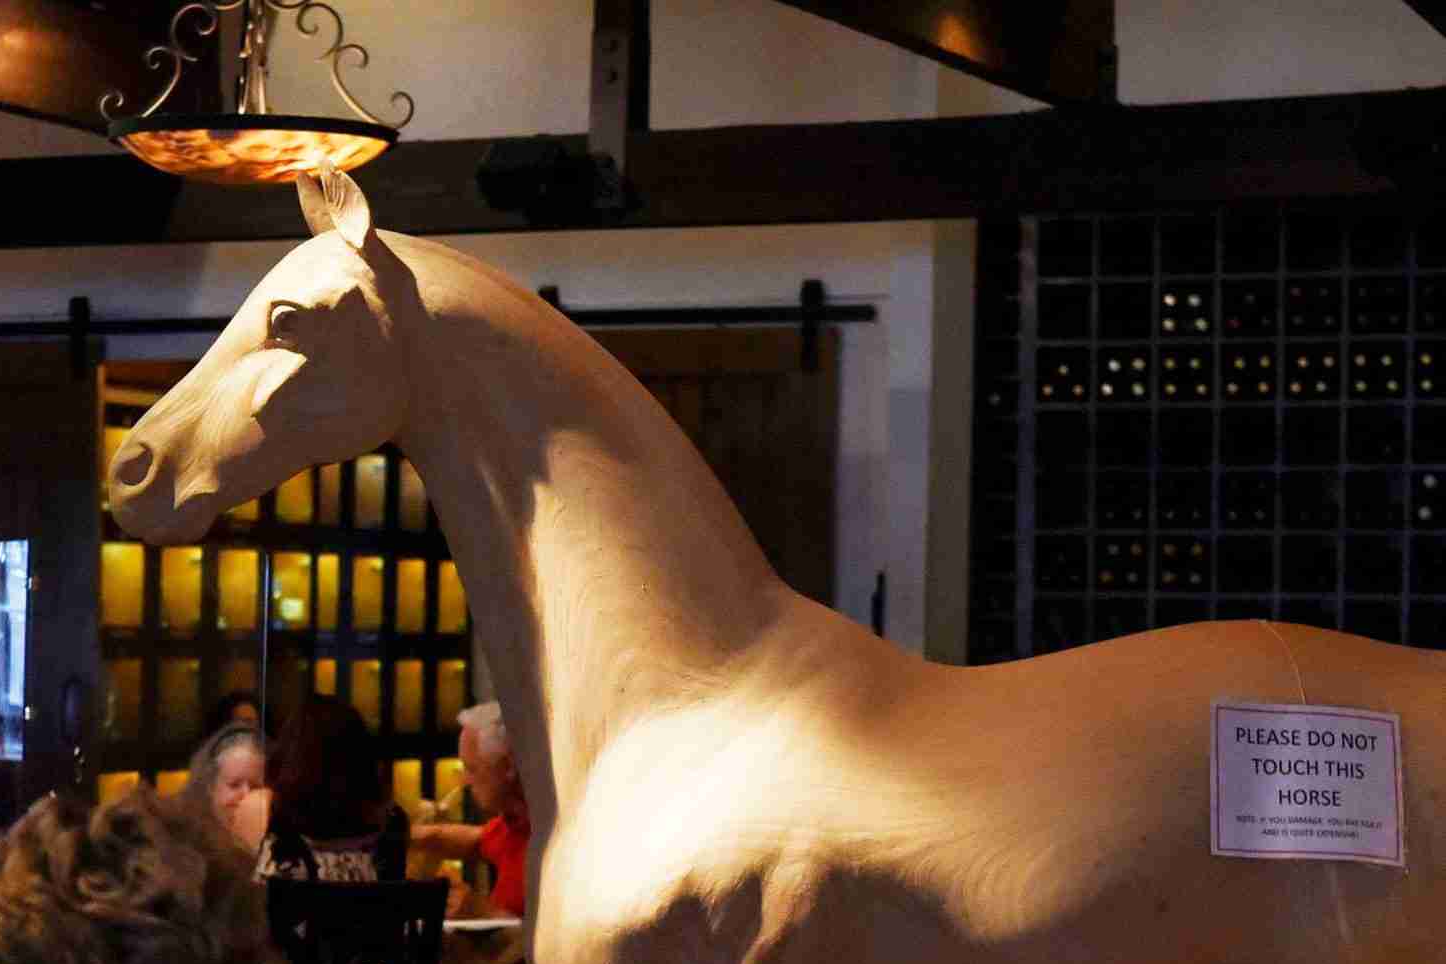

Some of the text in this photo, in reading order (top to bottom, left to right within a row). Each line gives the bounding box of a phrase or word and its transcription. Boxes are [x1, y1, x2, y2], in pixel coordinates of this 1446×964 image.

[1235, 727, 1378, 751] PLEASE DO NOT
[1252, 758, 1365, 780] TOUCH THIS
[1278, 789, 1342, 807] HORSE
